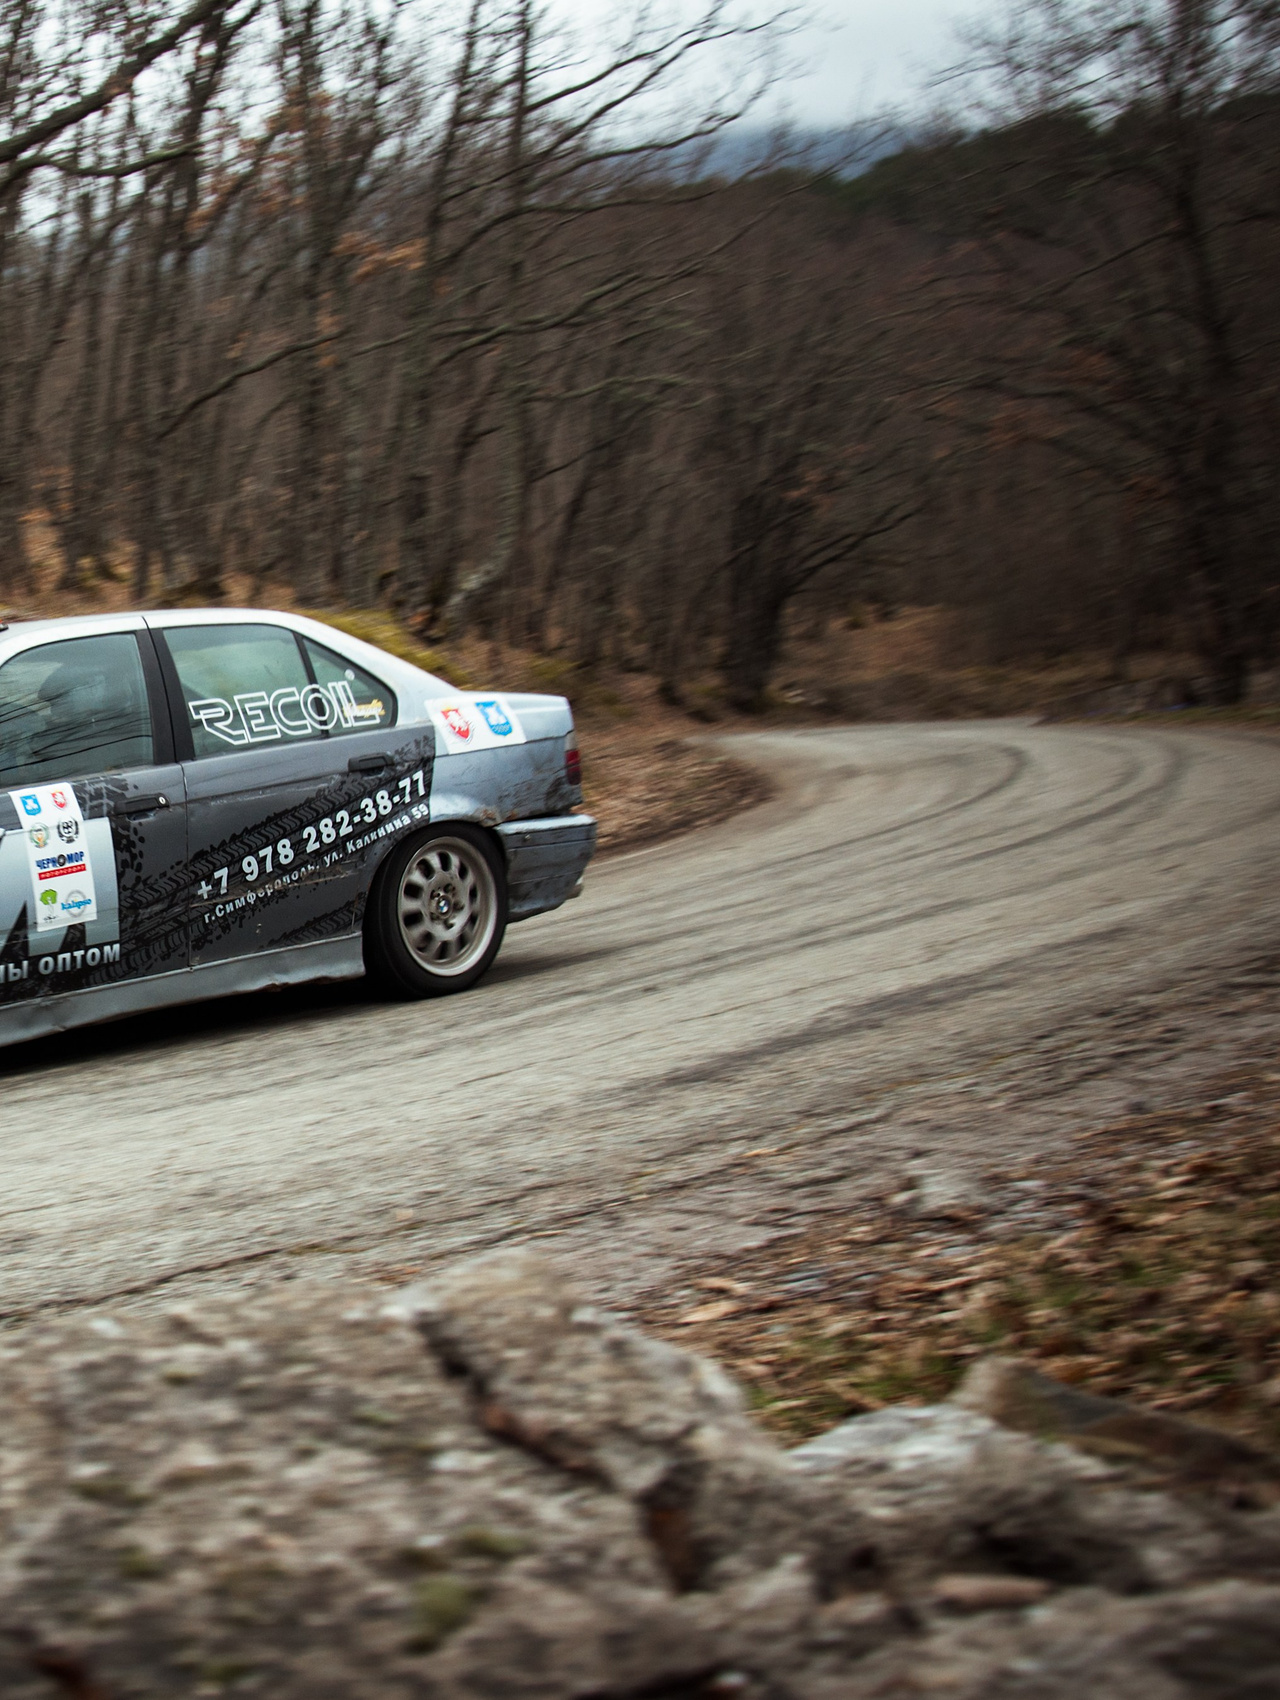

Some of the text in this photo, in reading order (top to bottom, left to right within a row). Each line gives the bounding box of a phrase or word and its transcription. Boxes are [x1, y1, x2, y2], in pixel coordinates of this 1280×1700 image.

[188, 680, 381, 746] RECOIL
[197, 769, 426, 900] +7 978 282-38-77
[323, 851, 344, 868] ул.
[345, 814, 412, 854] Калинина
[410, 803, 429, 820] 59
